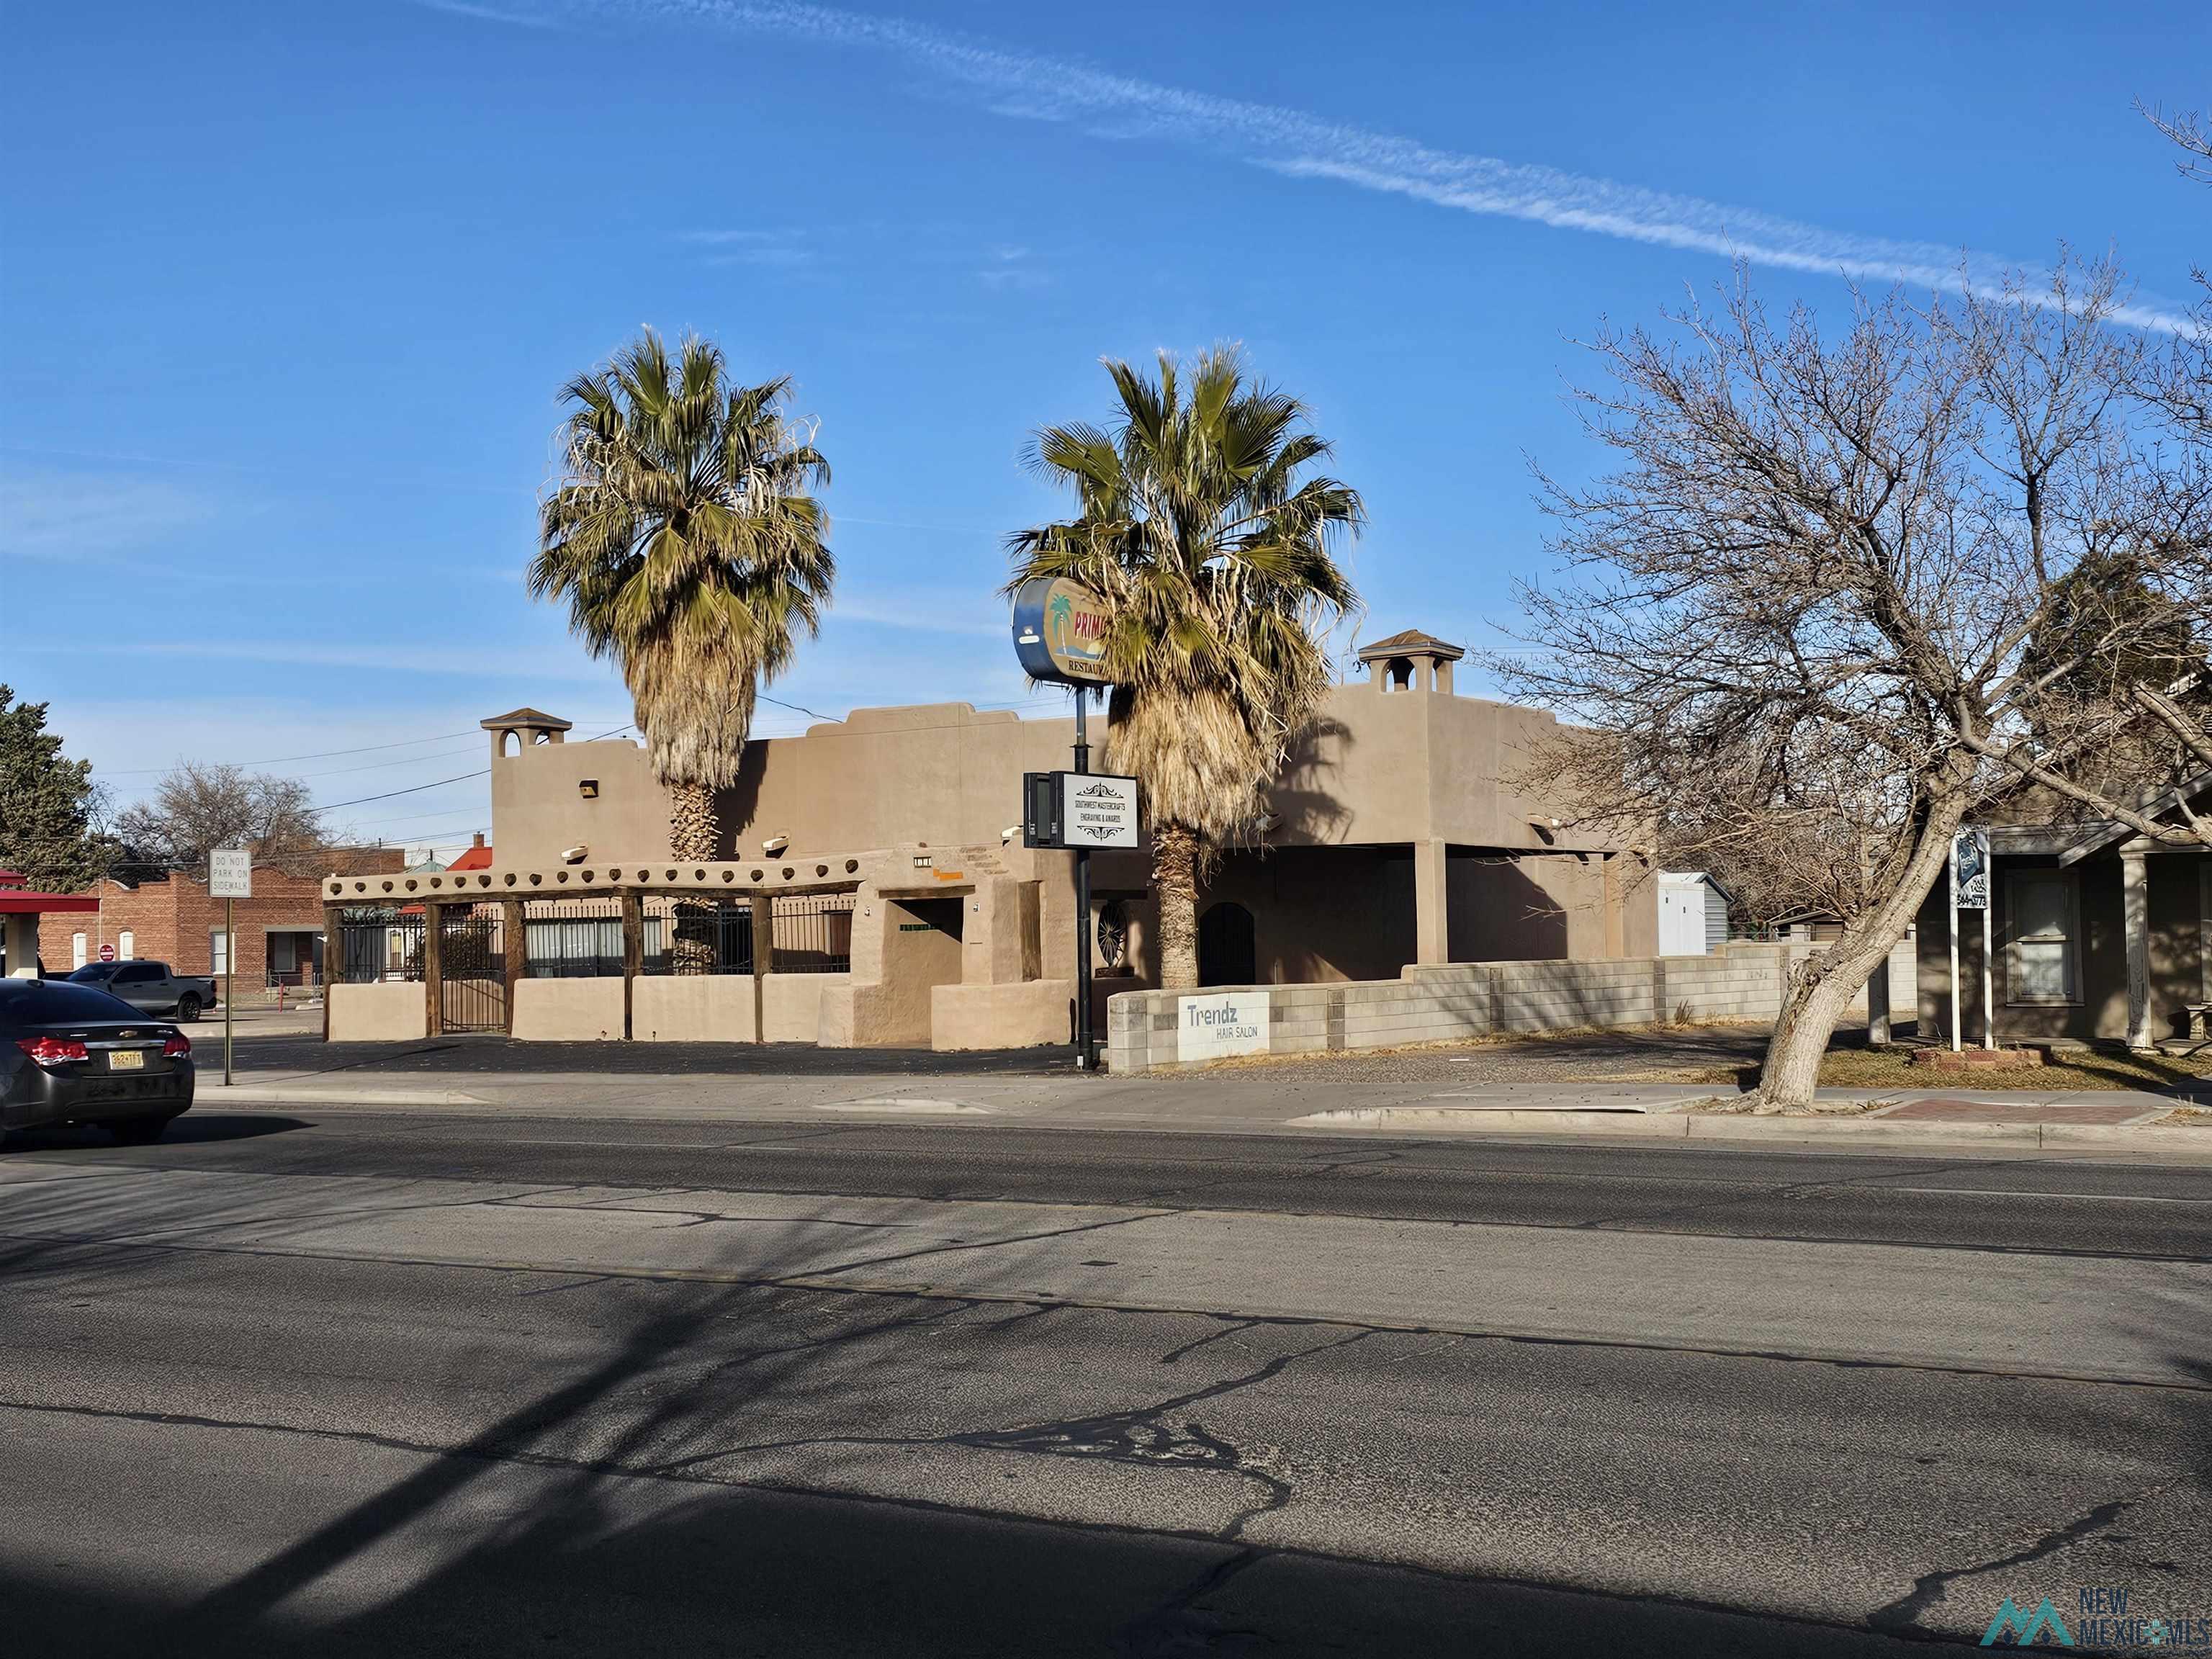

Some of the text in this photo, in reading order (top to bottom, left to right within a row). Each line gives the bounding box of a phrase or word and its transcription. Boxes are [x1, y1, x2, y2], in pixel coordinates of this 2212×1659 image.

[215, 857, 244, 866] DO NOT
[213, 869, 248, 878] PARK ON
[213, 881, 248, 891] SIDEWALK
[1187, 1001, 1238, 1026] Trendz
[1216, 1026, 1258, 1040] HAIR SALON
